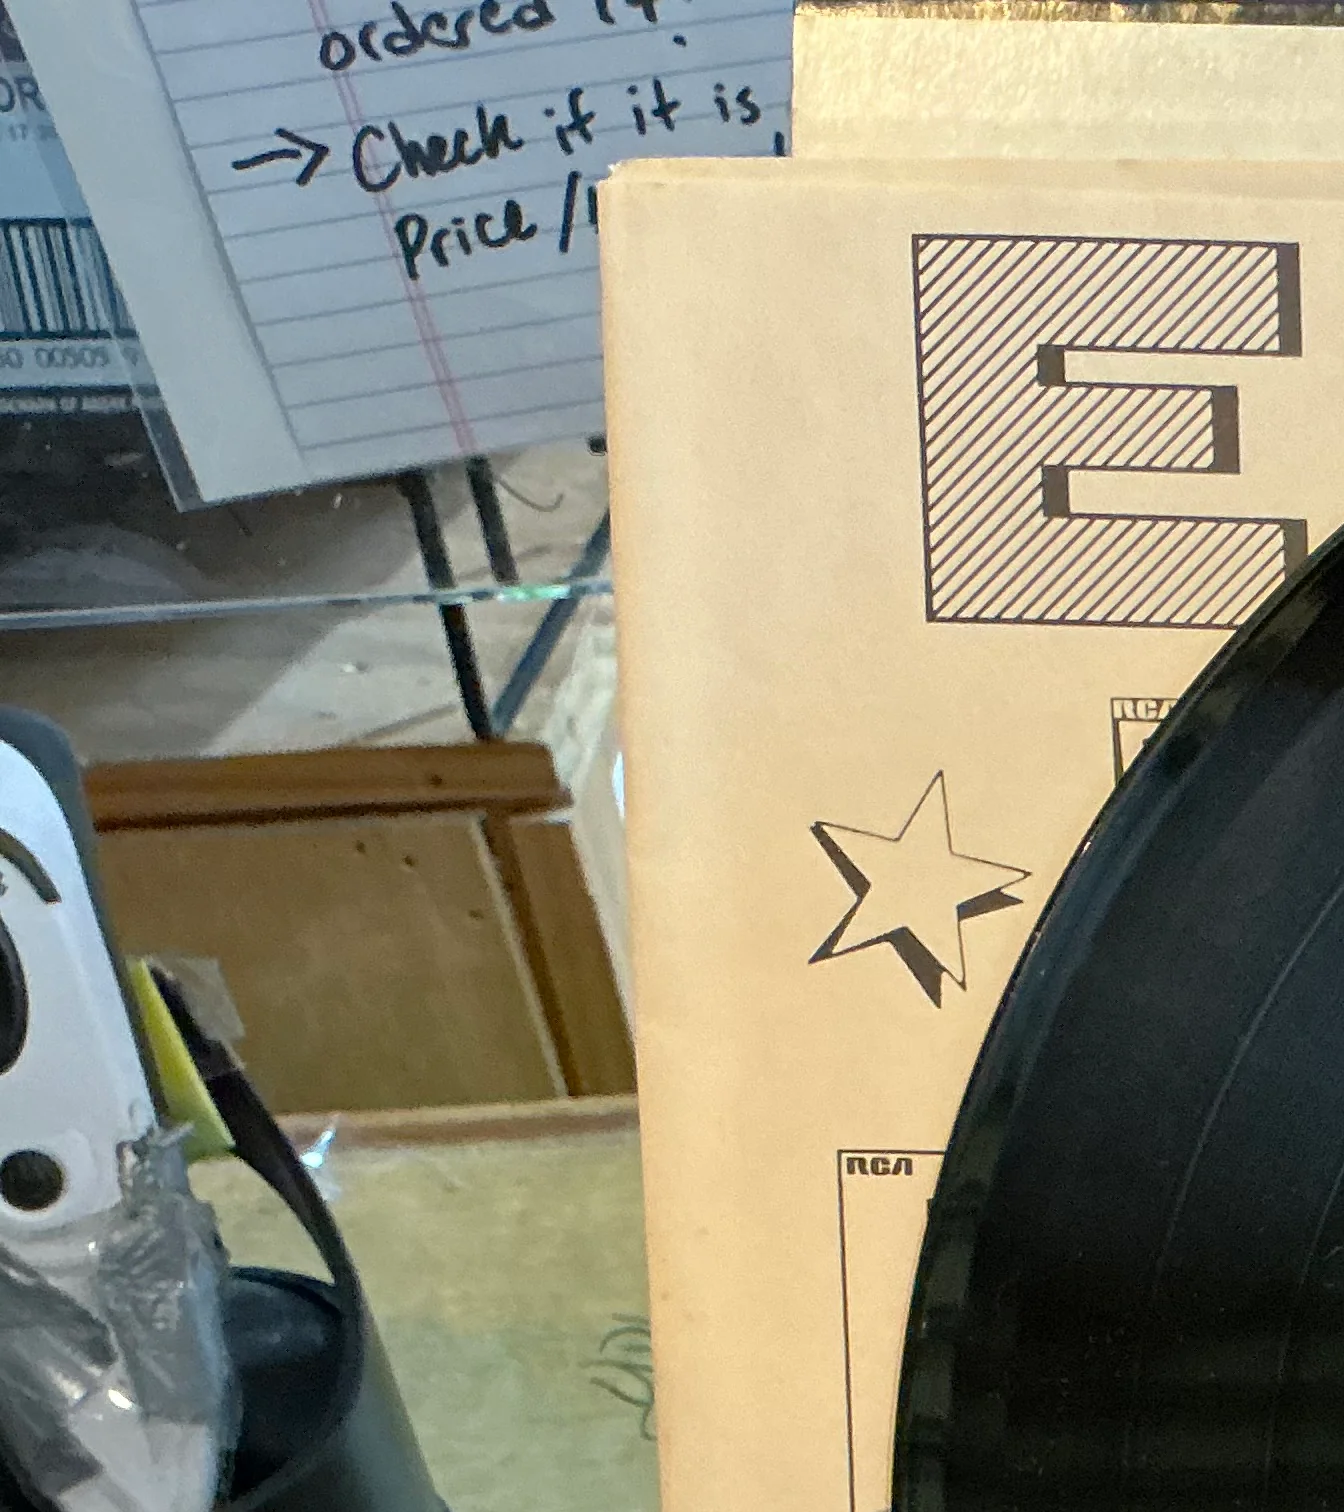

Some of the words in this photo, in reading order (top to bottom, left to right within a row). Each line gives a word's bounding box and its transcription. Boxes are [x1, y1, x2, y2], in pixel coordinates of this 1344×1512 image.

[352, 103, 523, 193] Check
[543, 87, 596, 156] if
[627, 77, 681, 136] it
[714, 82, 762, 126] is
[395, 199, 538, 280] Price
[846, 1157, 913, 1176] RCA
